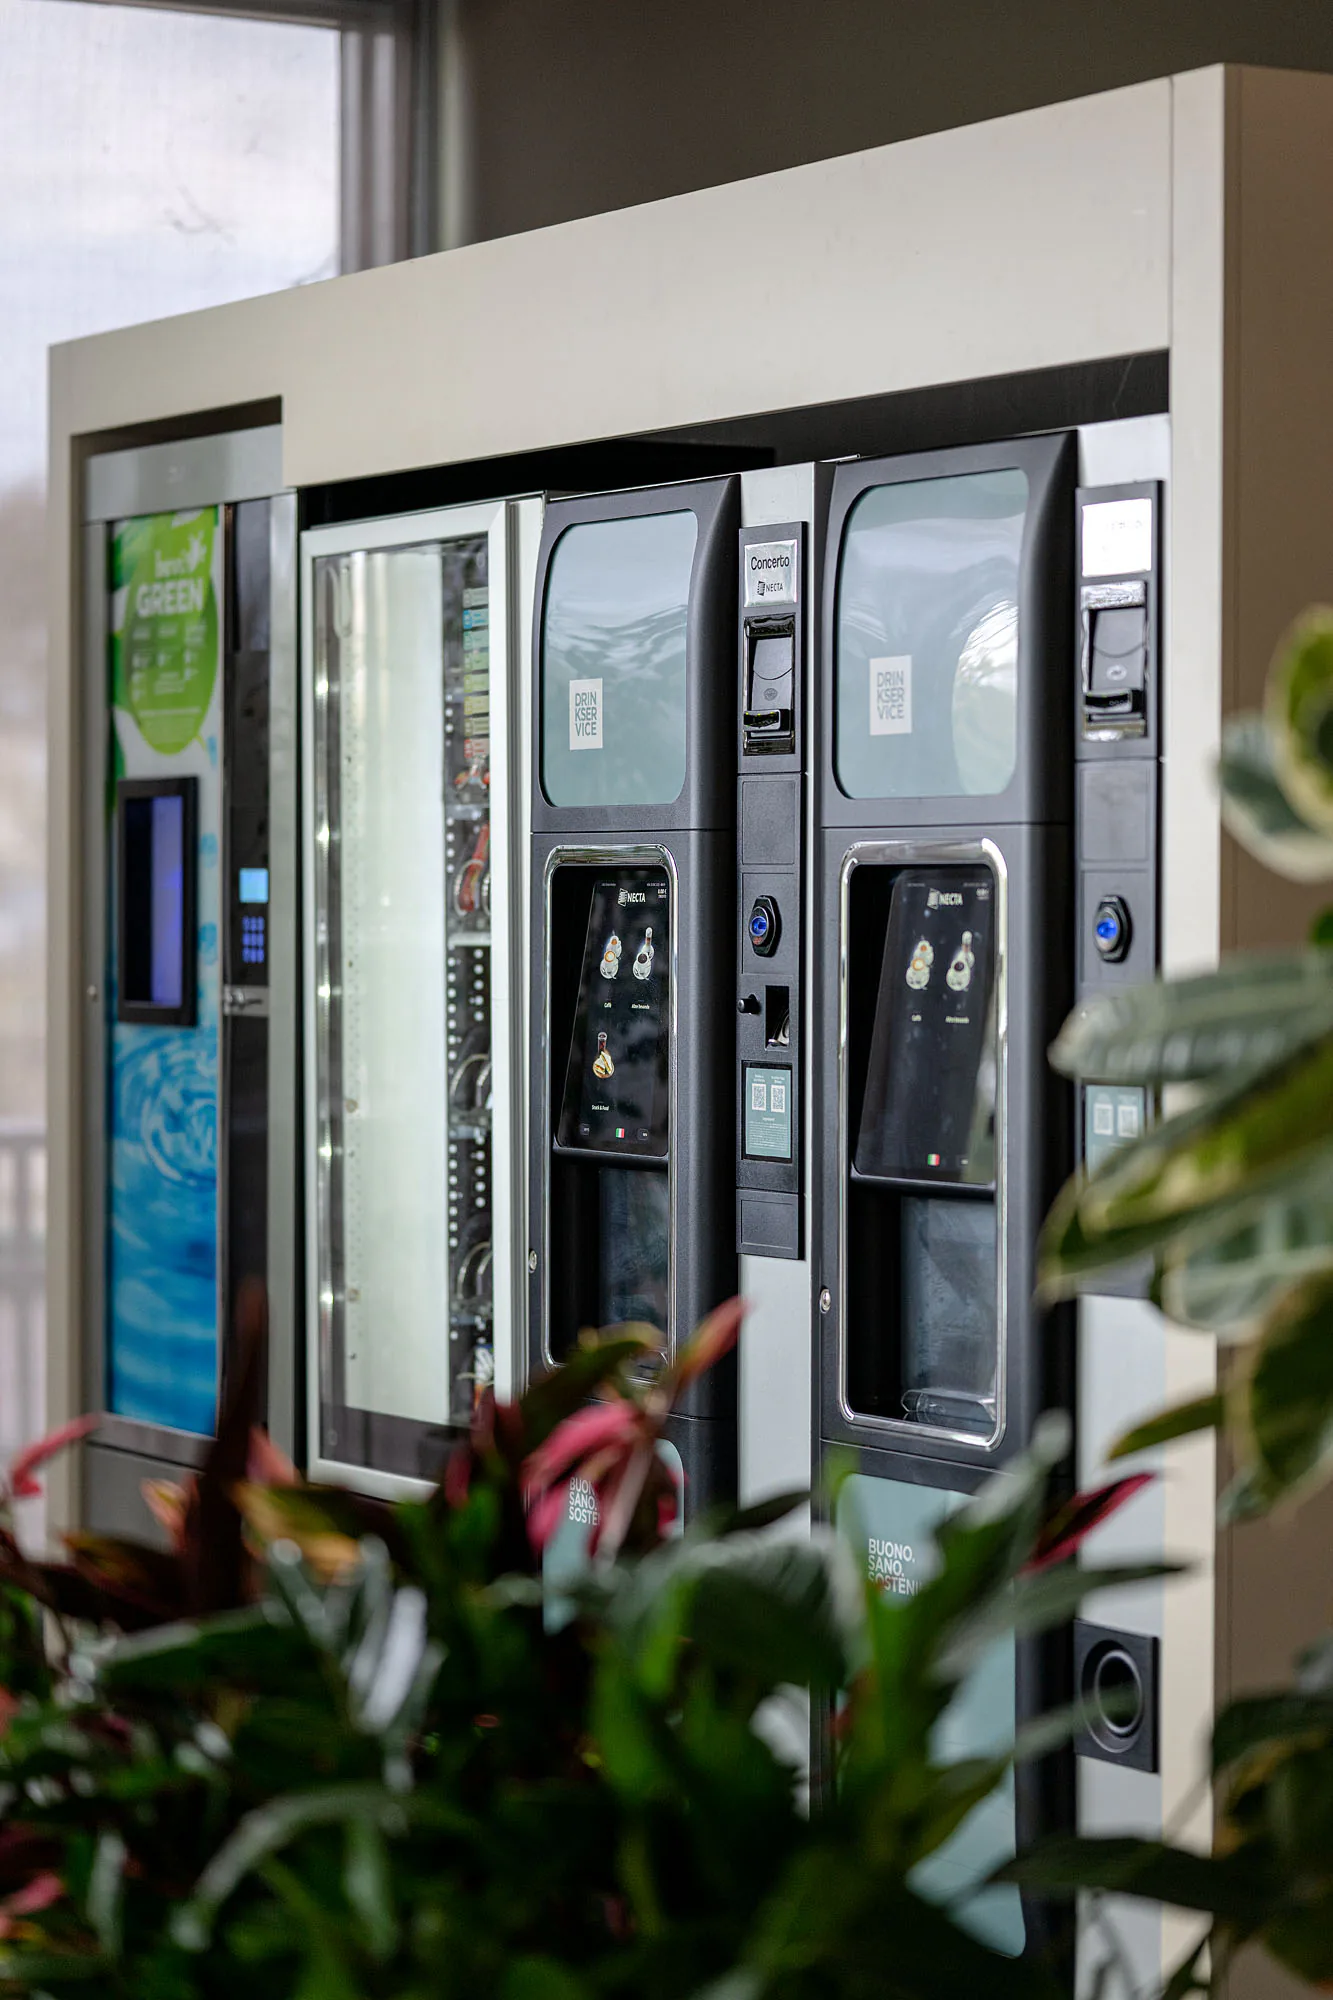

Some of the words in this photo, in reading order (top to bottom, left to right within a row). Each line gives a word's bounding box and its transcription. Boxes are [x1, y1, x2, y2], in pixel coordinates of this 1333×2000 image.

[751, 554, 790, 571] Concerto
[766, 582, 784, 592] NECTA
[136, 578, 203, 617] GREEN
[877, 670, 904, 688] DRIN
[574, 691, 597, 707] DRIN
[876, 687, 905, 703] KSER
[574, 706, 598, 722] KSER
[877, 704, 905, 720] VICE
[575, 721, 597, 737] VICE
[627, 892, 646, 903] NECTA
[570, 1476, 596, 1496] BUON
[569, 1491, 598, 1512] SANO.
[868, 1537, 916, 1564] BUONO.
[868, 1554, 905, 1578] SANO.
[868, 1571, 920, 1597] SOSTENI
